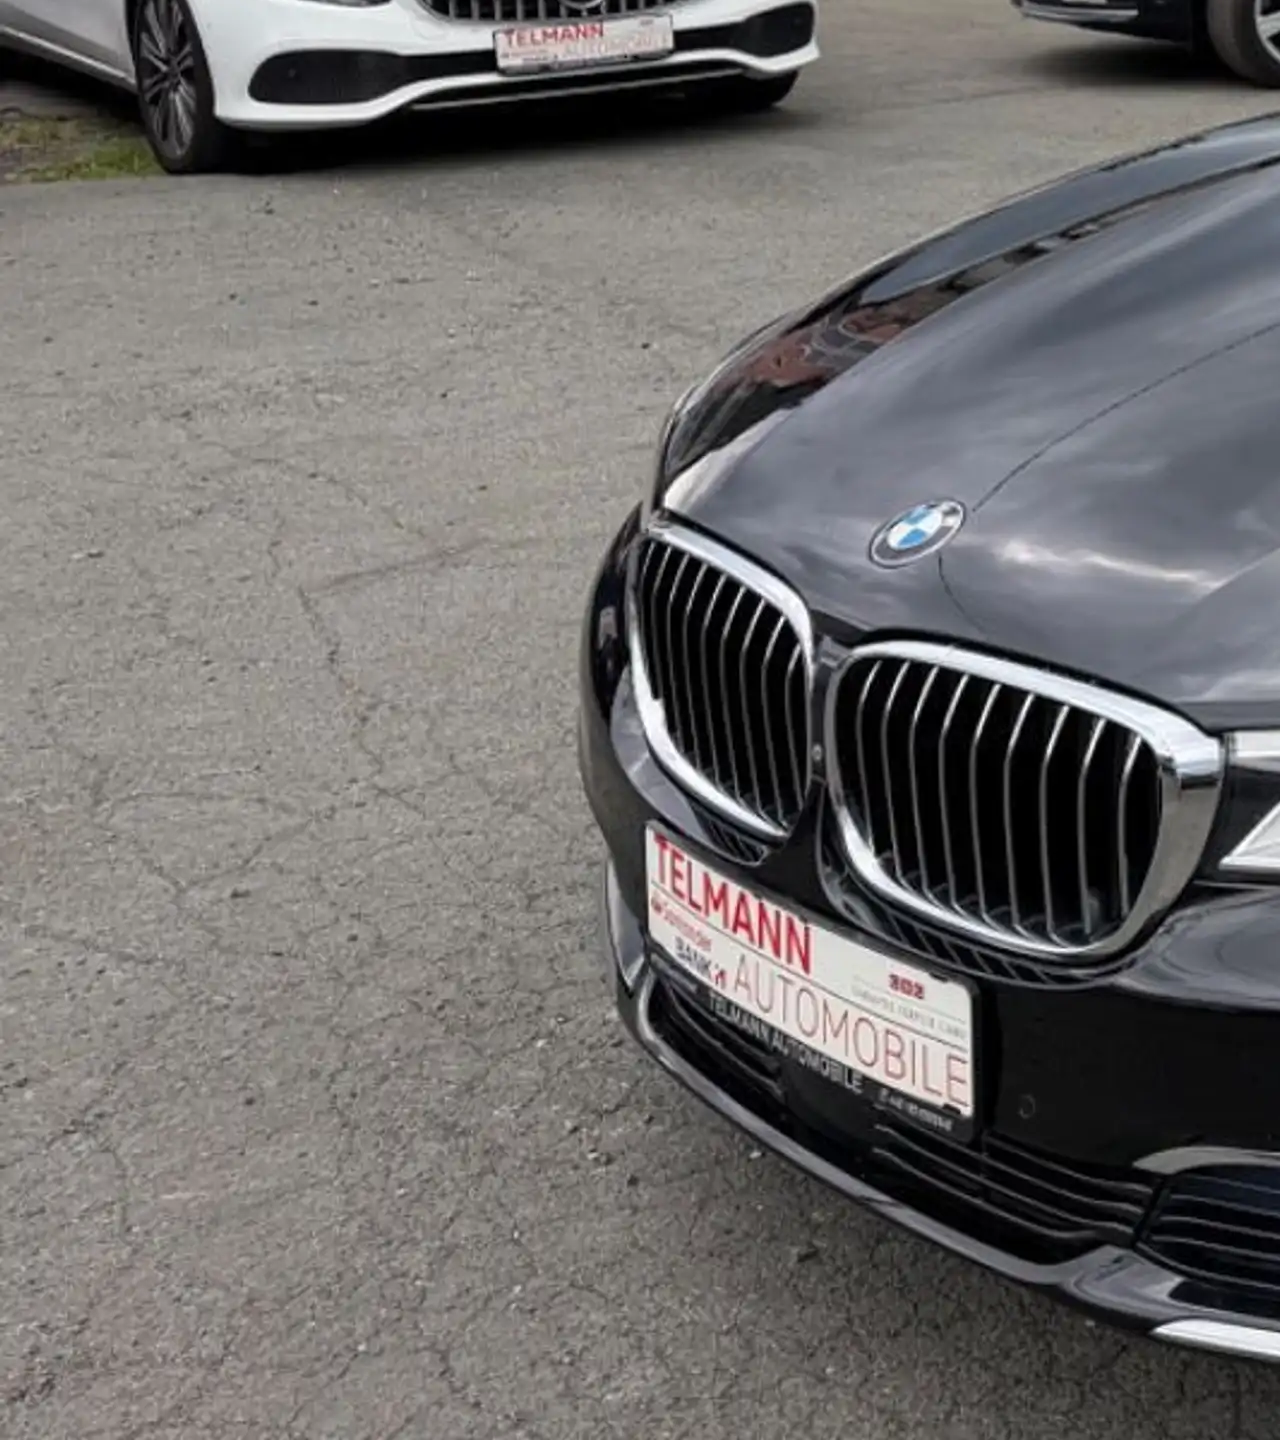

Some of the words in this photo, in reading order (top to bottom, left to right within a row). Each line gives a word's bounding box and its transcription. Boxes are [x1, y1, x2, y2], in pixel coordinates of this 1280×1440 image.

[503, 21, 604, 48] TELMANN
[654, 832, 810, 975] TELMANN
[709, 990, 770, 1046] TELMANN
[770, 1028, 866, 1094] AUTOMOBILE
[735, 954, 969, 1108] AUTOMOBILE
